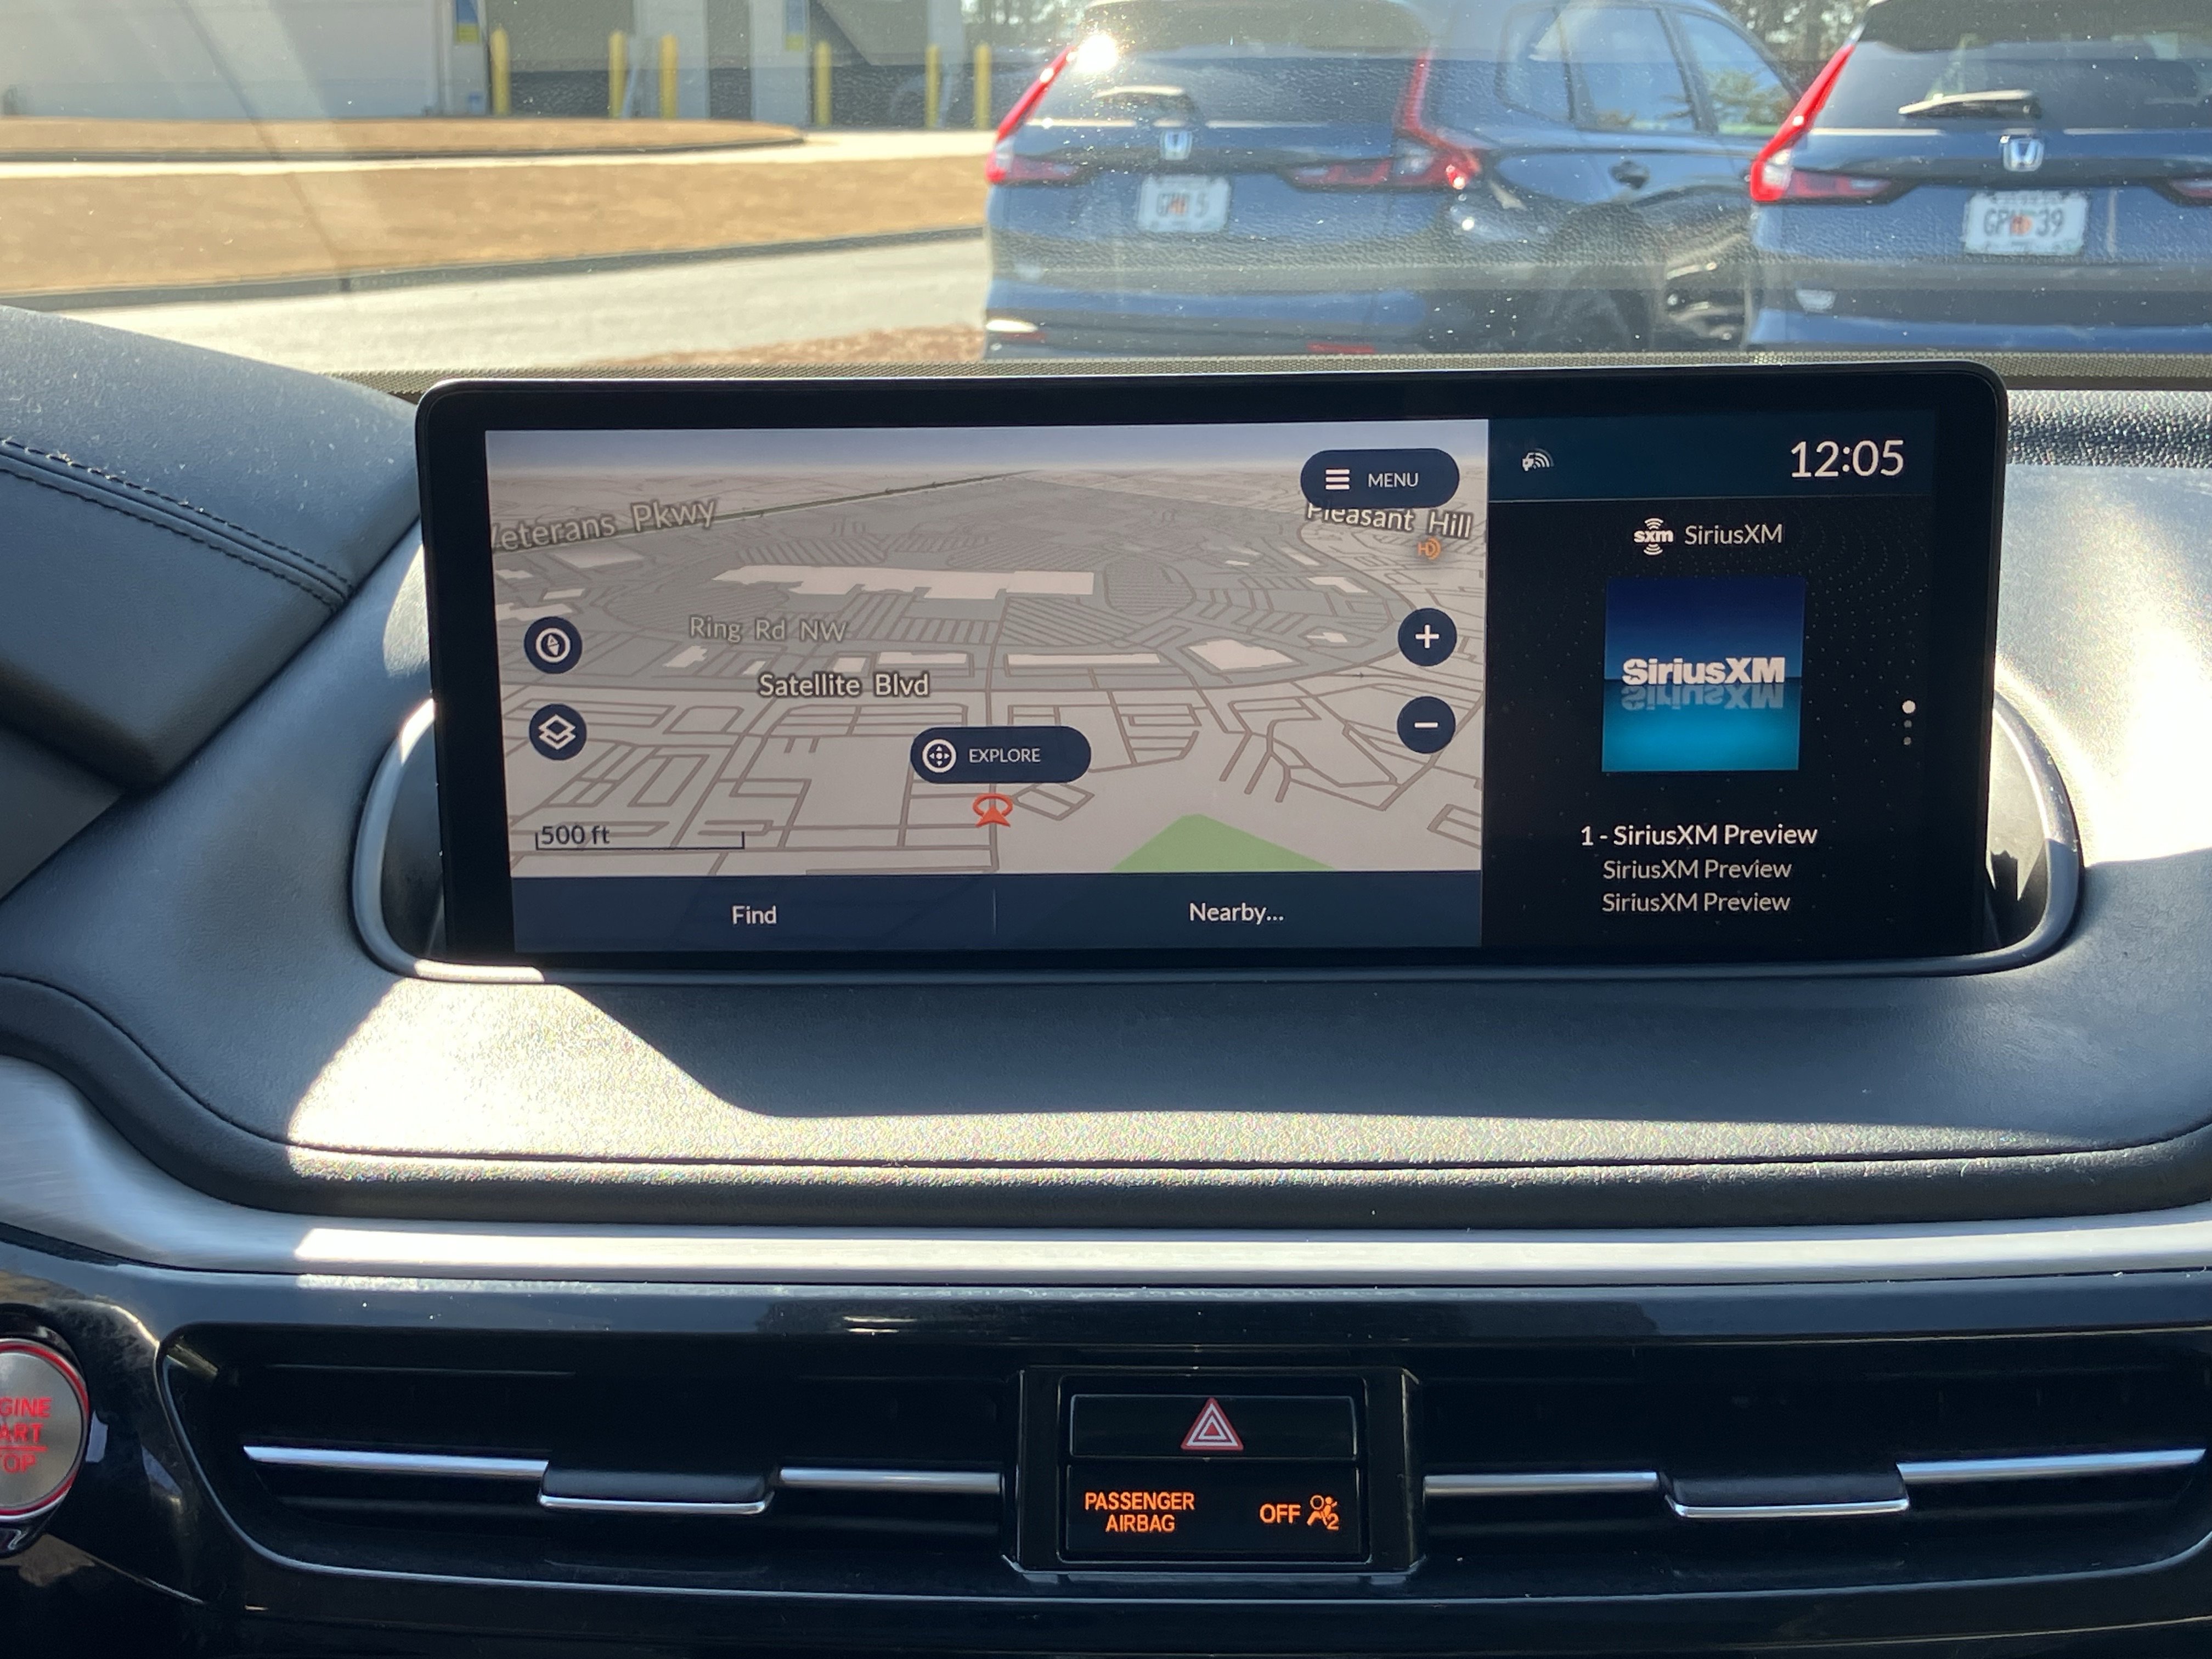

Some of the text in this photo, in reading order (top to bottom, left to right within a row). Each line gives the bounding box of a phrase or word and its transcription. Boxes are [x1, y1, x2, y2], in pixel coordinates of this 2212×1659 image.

[1791, 440, 1904, 478] 12:05
[1368, 472, 1419, 488] MENU
[631, 499, 715, 532] Pkwy
[1429, 511, 1472, 538] Hill
[1634, 524, 1782, 545] sxm SiriusXM
[690, 616, 848, 642] Ring Rd NW
[1622, 657, 1785, 685] SiriusXM
[758, 674, 929, 697] Satellite Blvd
[969, 748, 1041, 763] EXPLORE
[541, 825, 610, 845] 500 ft
[1581, 826, 1594, 845] 1
[1613, 825, 1717, 845] SiriusXM
[1724, 824, 1818, 844] Preview
[1603, 859, 1792, 879] SiriusXM Preview
[1602, 893, 1791, 912] SiriusXM Preview
[732, 905, 777, 924] Find
[1189, 902, 1284, 925] Nearby...
[0, 1454, 36, 1474] OP
[1085, 1492, 1194, 1510] PASSENGER
[1106, 1515, 1175, 1532] AIRBAG
[1260, 1504, 1301, 1523] OFF
